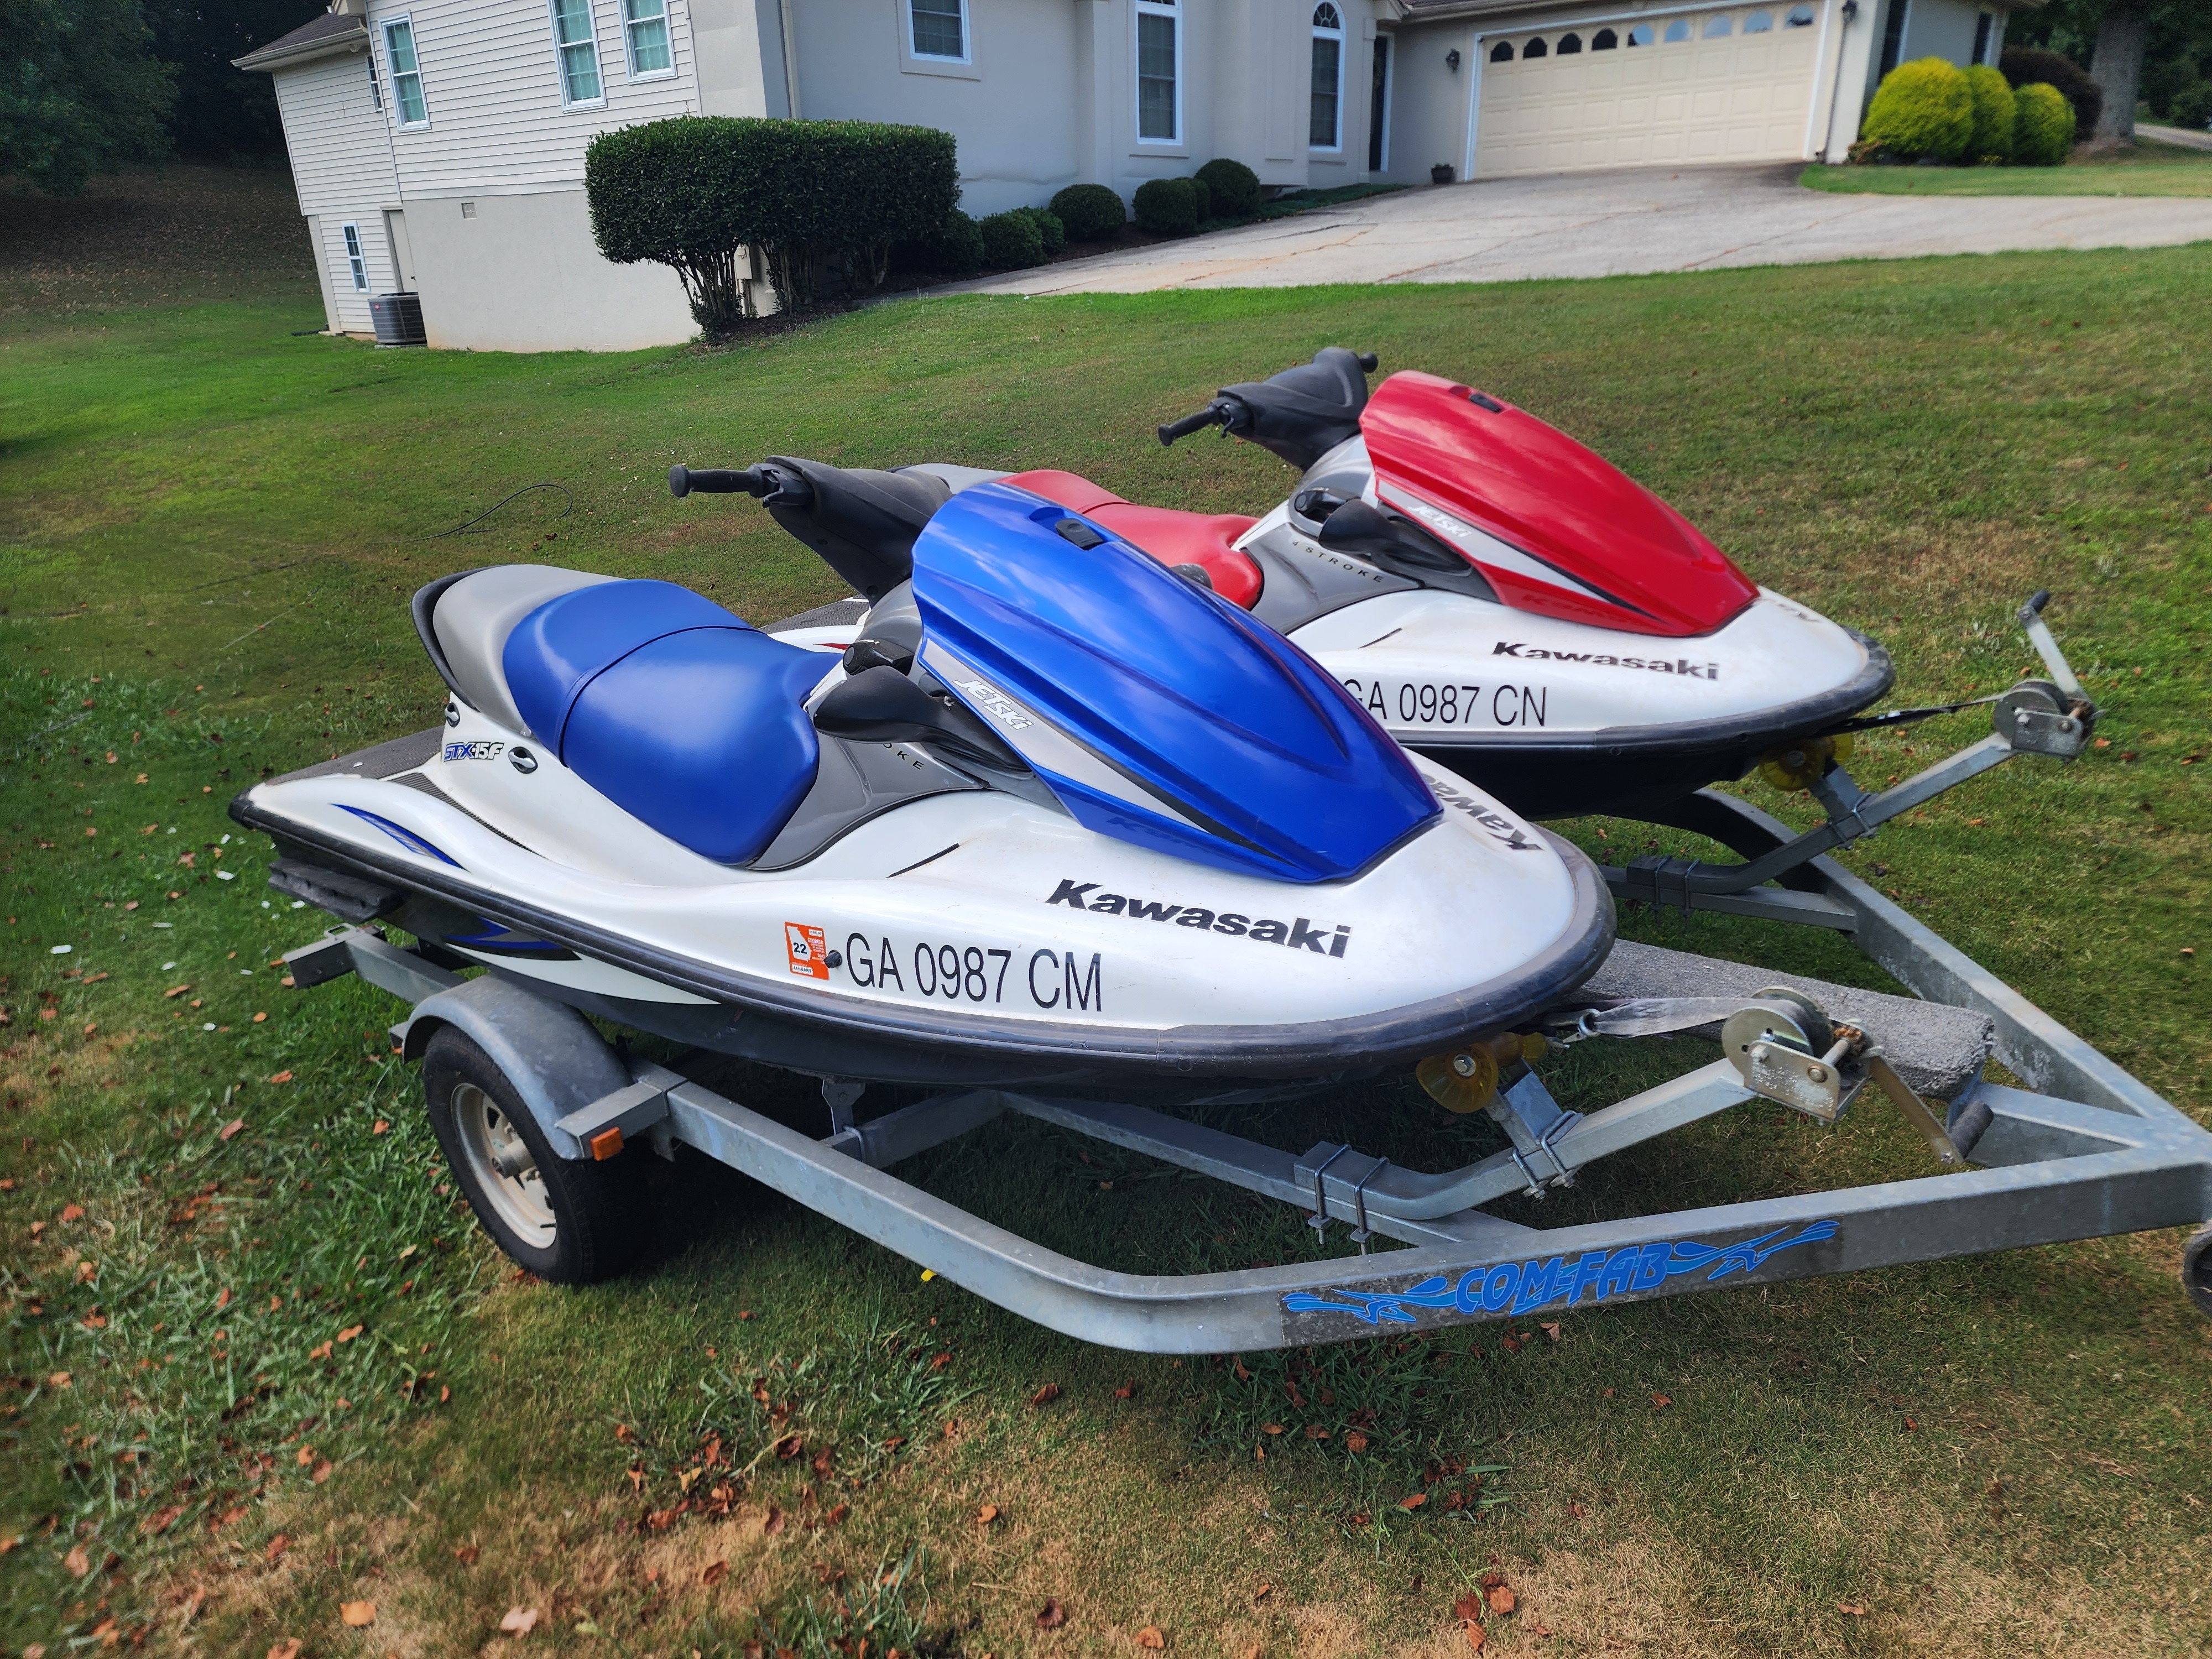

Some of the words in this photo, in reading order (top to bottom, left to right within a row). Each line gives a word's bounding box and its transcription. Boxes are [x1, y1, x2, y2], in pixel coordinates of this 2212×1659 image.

[1305, 546, 1385, 583] STROKE
[1491, 641, 1720, 681] Kawasaki
[1399, 683, 1480, 724] 0987
[1493, 685, 1547, 727] CN
[1044, 879, 1352, 958] Kawasaki
[793, 942, 807, 954] 22
[846, 932, 906, 993] GA
[916, 942, 1012, 1003] 0987
[1029, 948, 1103, 1012] CM
[1455, 1242, 1673, 1315] COM-FAB
